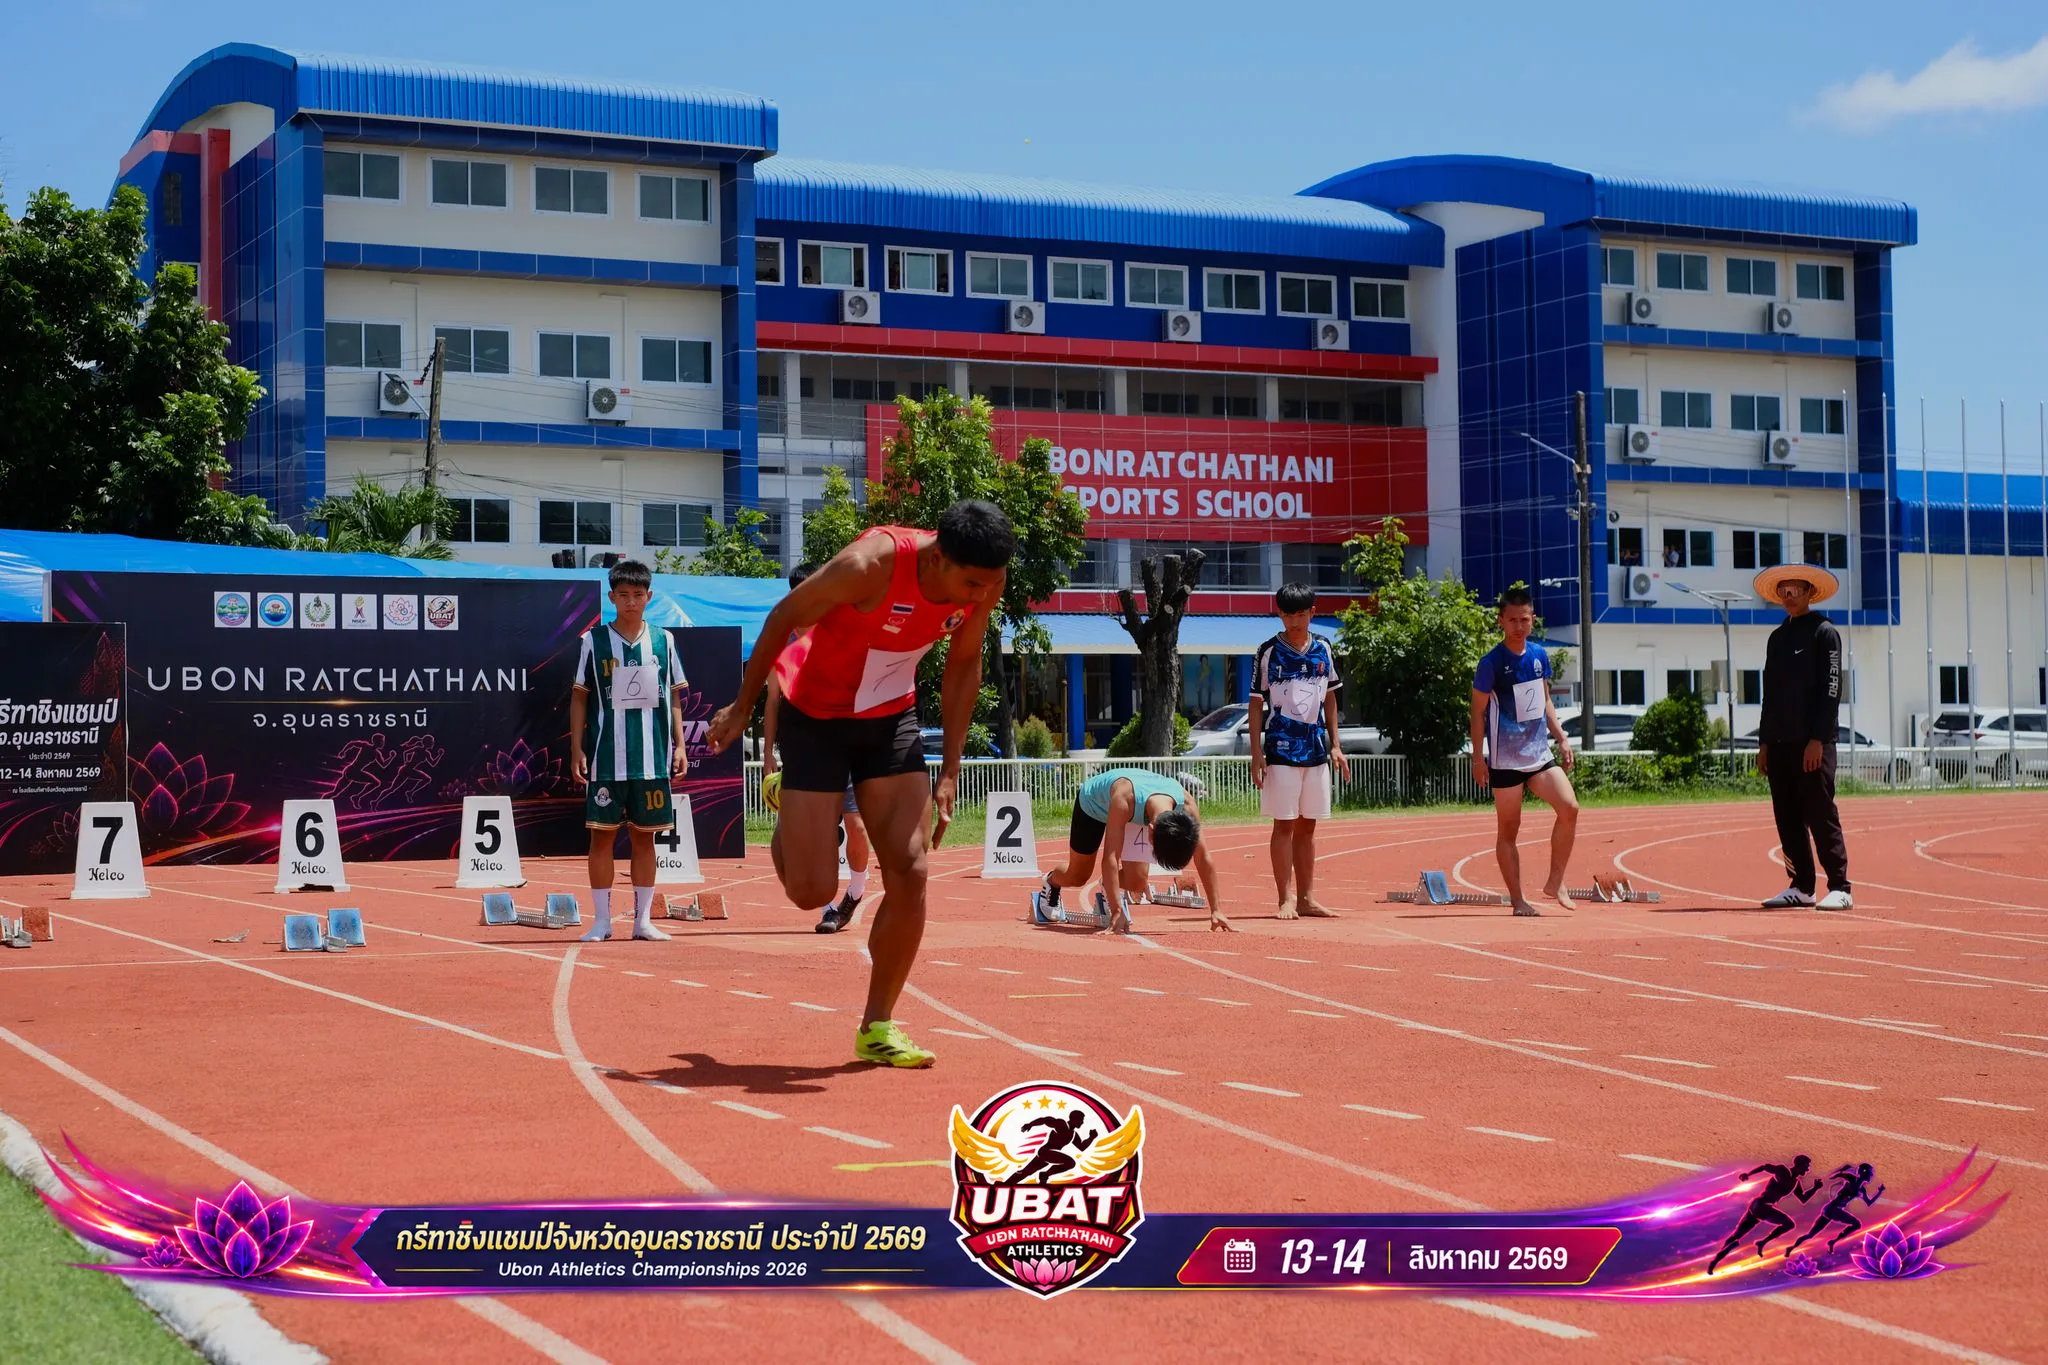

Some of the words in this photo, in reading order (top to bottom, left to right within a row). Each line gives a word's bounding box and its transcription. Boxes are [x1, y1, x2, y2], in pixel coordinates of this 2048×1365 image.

[1197, 489, 1312, 519] SCHOOL
[1829, 650, 1839, 675] NIKE
[147, 666, 265, 692] UBON
[285, 667, 527, 692] RATCHATHANI
[627, 670, 641, 697] 6
[1829, 675, 1839, 698] PRO
[1290, 689, 1313, 716] 3
[1525, 688, 1537, 713] 2
[253, 707, 427, 734] จ.อุบลราชธานี
[28, 752, 53, 760] ประจำปี
[53, 752, 71, 760] 2569
[35, 766, 73, 779] สิงหาคม
[75, 766, 101, 778] 2569
[645, 789, 665, 810] 10
[296, 811, 325, 858] 6
[475, 810, 502, 855] 5
[654, 809, 681, 853] 4
[996, 805, 1022, 848] 2
[93, 816, 123, 865] 7
[1133, 827, 1148, 854] 4
[291, 861, 326, 875] Nelco
[470, 858, 503, 871] Nelco
[993, 851, 1024, 864] Nelco
[88, 867, 125, 881] Nelco
